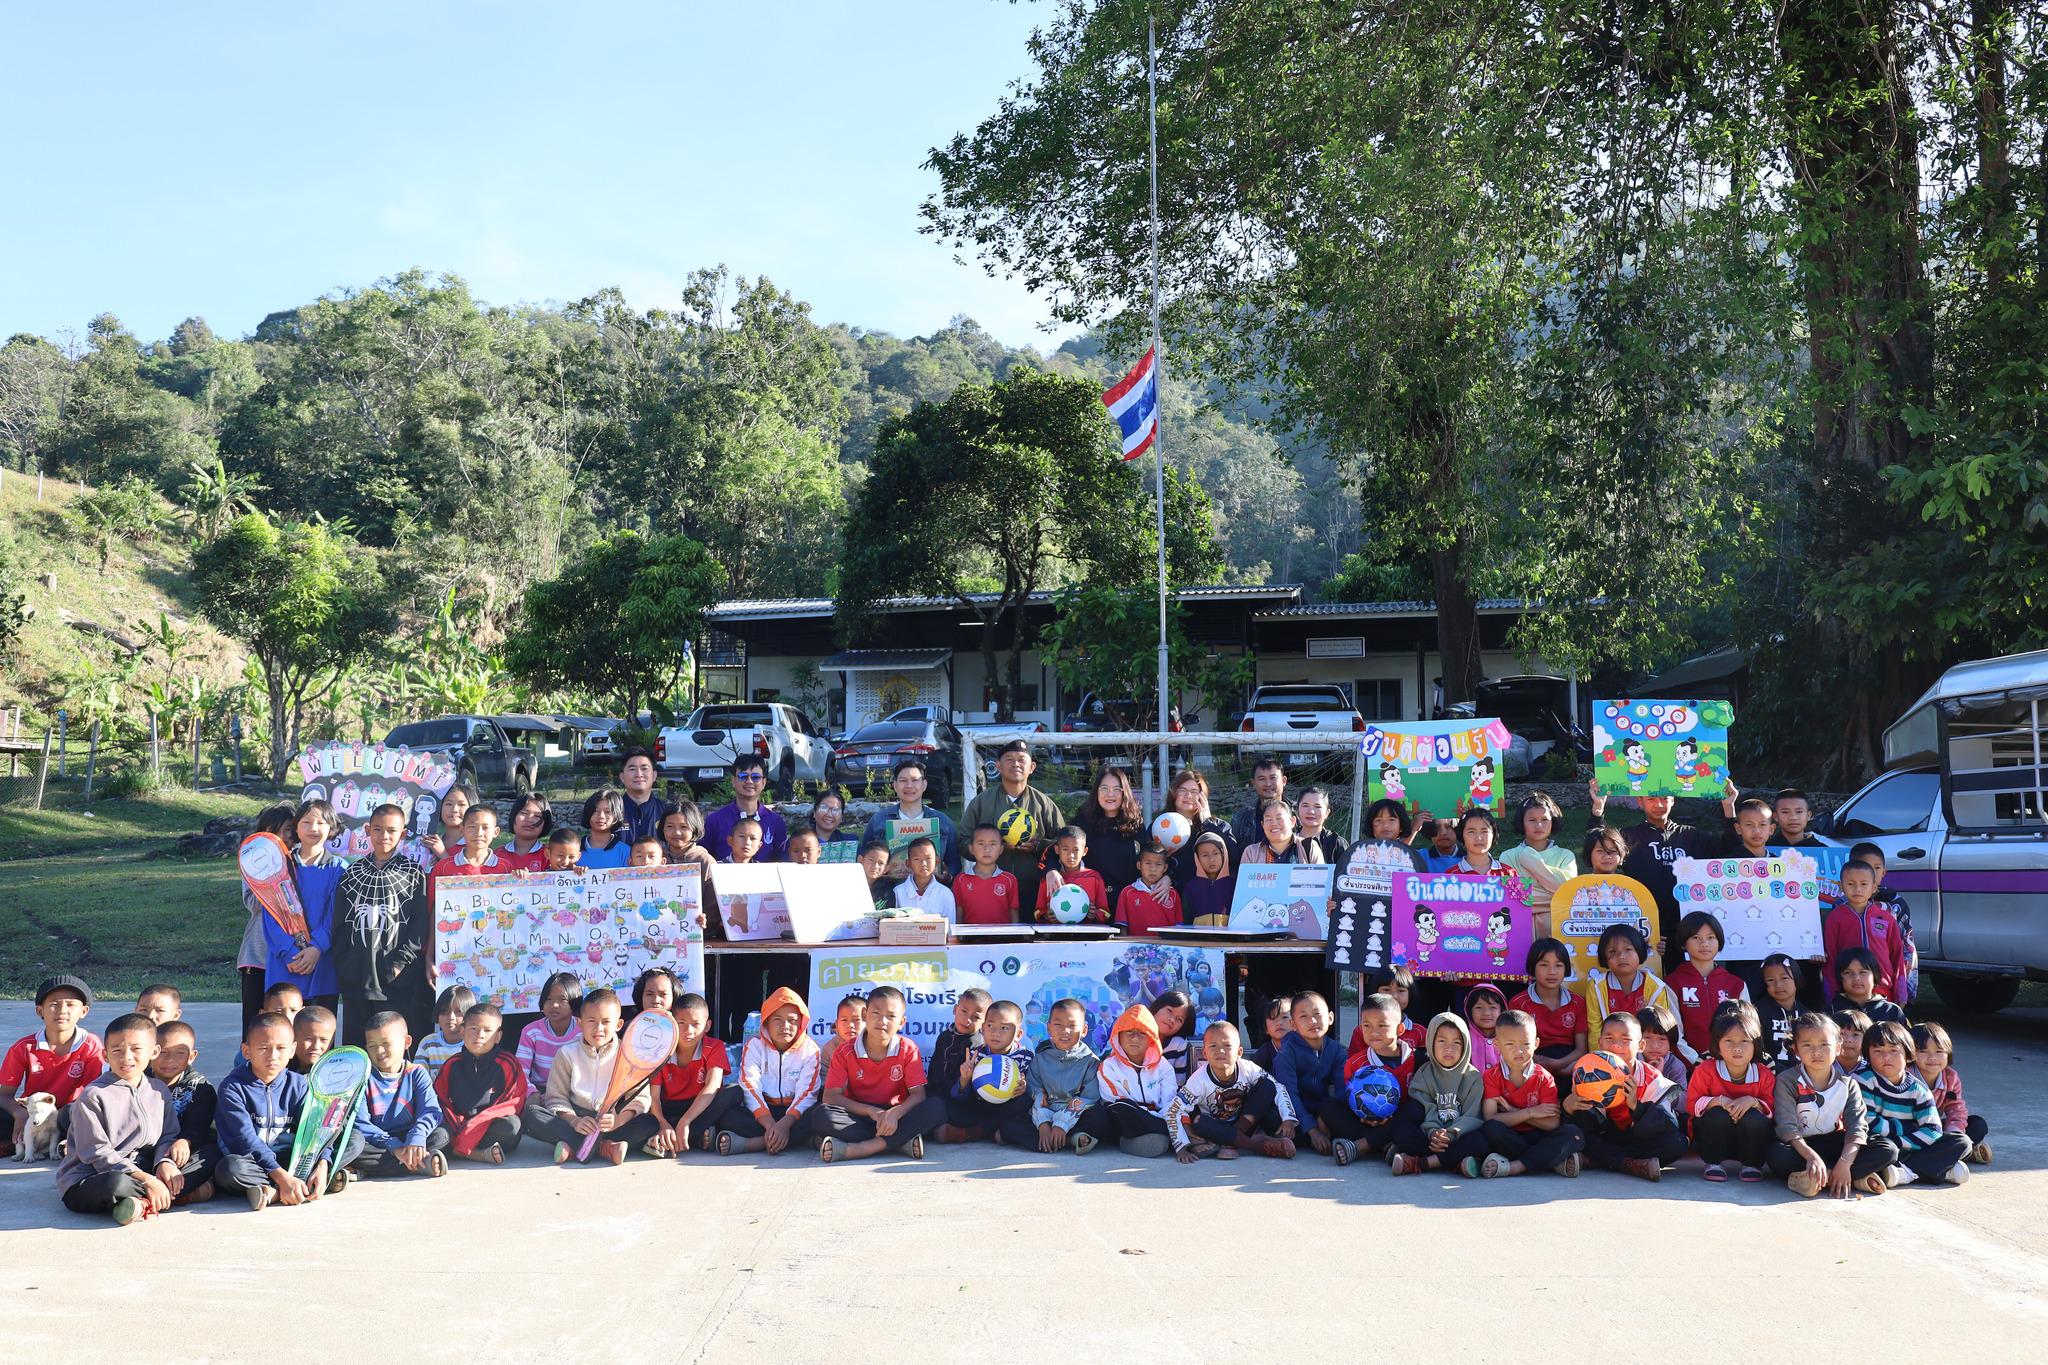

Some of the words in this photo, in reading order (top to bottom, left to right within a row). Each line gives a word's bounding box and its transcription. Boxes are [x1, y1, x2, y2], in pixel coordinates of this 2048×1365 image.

[1362, 723, 1508, 762] ยินดีต้อนรับ
[308, 752, 448, 788] WELCOME
[900, 825, 924, 833] MAMA
[1711, 862, 1782, 875] สมาชิก
[556, 875, 587, 887] อักษร
[591, 874, 607, 885] A-Z
[1248, 880, 1277, 888] BEARS
[1406, 876, 1505, 902] ยินดีต้อนรับ
[443, 900, 460, 913] Aa
[472, 895, 491, 908] Bb
[501, 892, 520, 905] Cc
[531, 893, 549, 905] Dd
[558, 892, 574, 904] Ee
[587, 891, 602, 903] Ff
[615, 888, 633, 902] Gg
[644, 886, 661, 899] Hh
[676, 885, 689, 897] Ii
[1678, 883, 1814, 898] ในห้องเรียน
[442, 940, 457, 954] Jj
[474, 935, 492, 948] Kk
[502, 933, 516, 945] Ll
[529, 933, 550, 946] Mm
[558, 933, 575, 945] Nn
[589, 928, 609, 940] Oo
[619, 927, 636, 939] Pp
[648, 924, 666, 938] Qq
[679, 920, 695, 933] Rr
[1638, 918, 1650, 938] 5
[515, 973, 533, 986] Uu
[602, 967, 620, 980] Xx
[823, 957, 944, 984] ค่ายอาสา
[1682, 987, 1700, 1001] K
